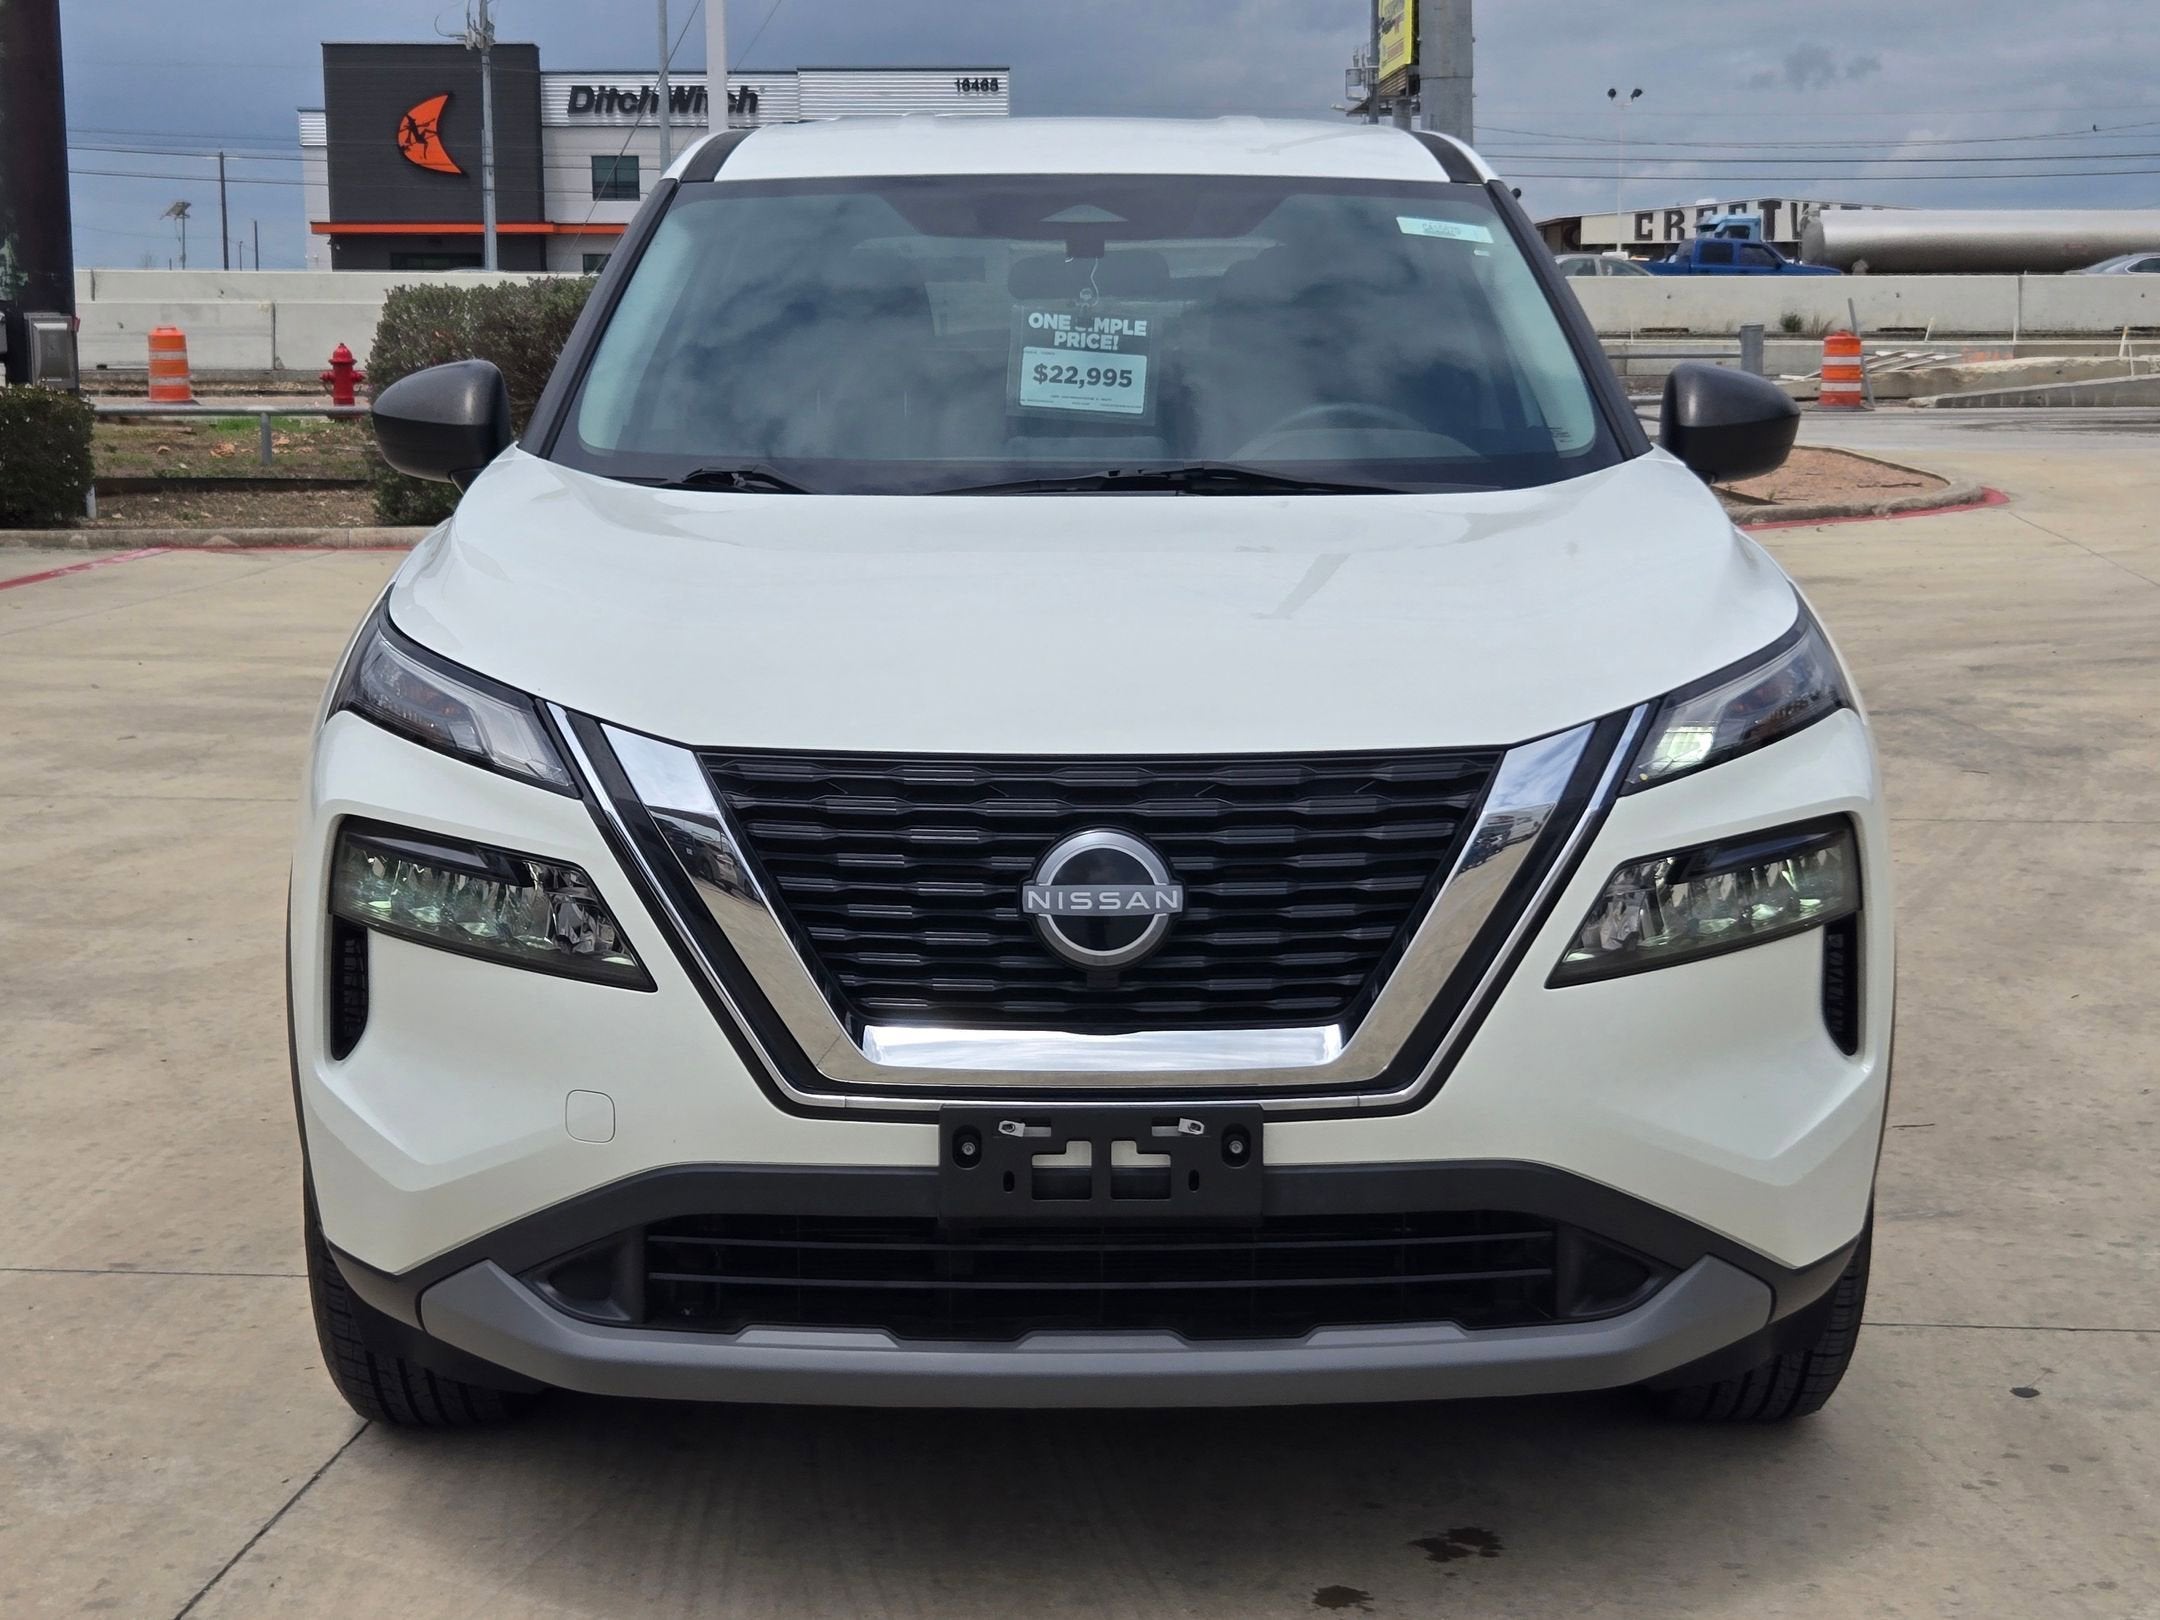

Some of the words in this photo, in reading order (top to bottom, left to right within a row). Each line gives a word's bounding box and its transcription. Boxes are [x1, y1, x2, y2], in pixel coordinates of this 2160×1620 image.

[567, 85, 660, 114] Ditch
[1028, 312, 1072, 330] ONE
[1075, 317, 1148, 336] MPLE
[1054, 331, 1120, 350] PRICE!
[1032, 363, 1133, 389] $22,995
[1028, 890, 1178, 910] NISSAN
